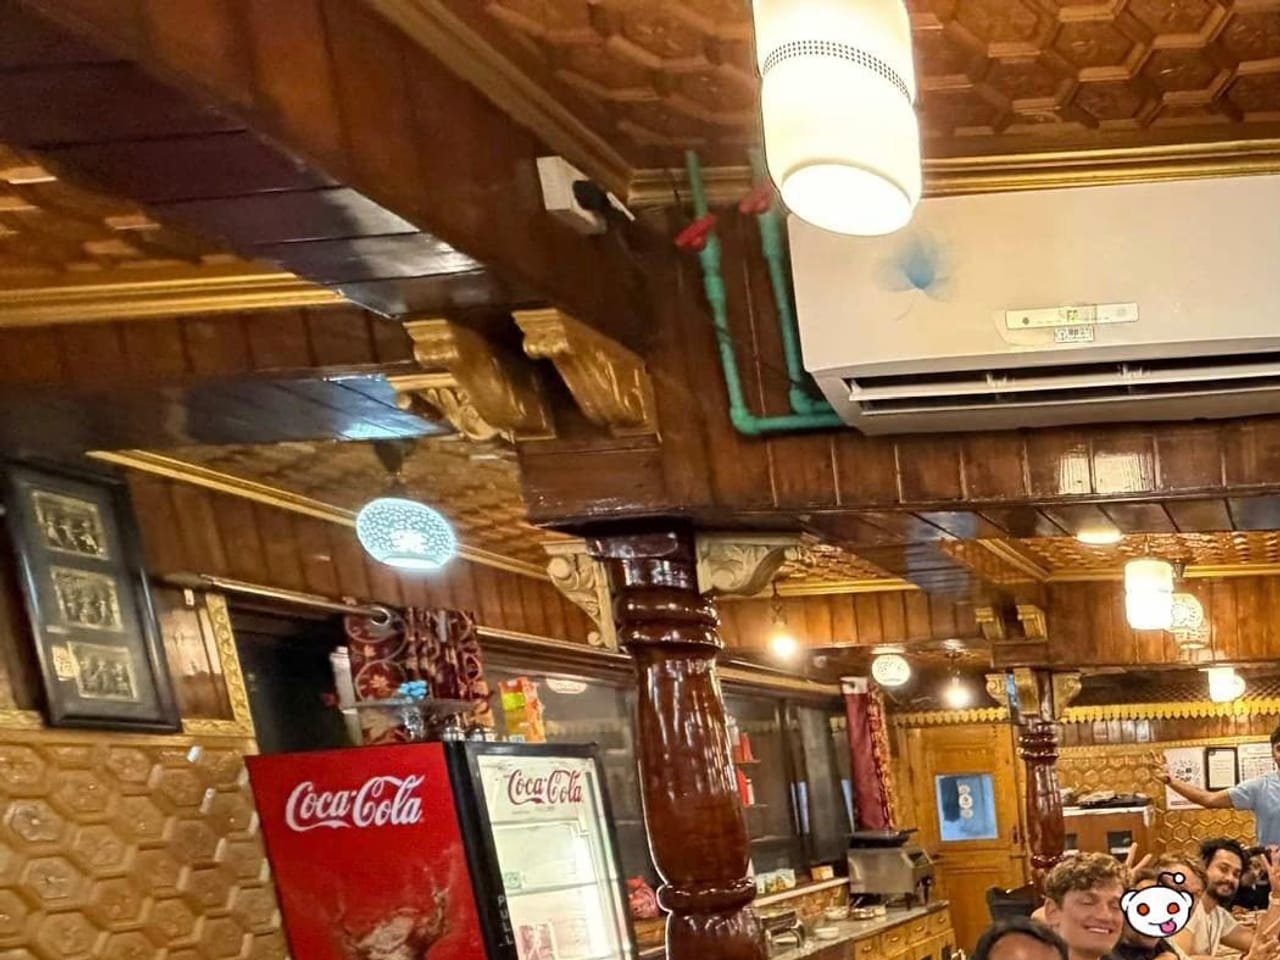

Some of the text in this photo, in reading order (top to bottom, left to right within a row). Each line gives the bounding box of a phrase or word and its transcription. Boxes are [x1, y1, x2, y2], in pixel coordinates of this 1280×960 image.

[285, 775, 425, 832] Coca-Cola
[508, 769, 583, 806] Coca-Cola
[498, 895, 514, 945] PULL
